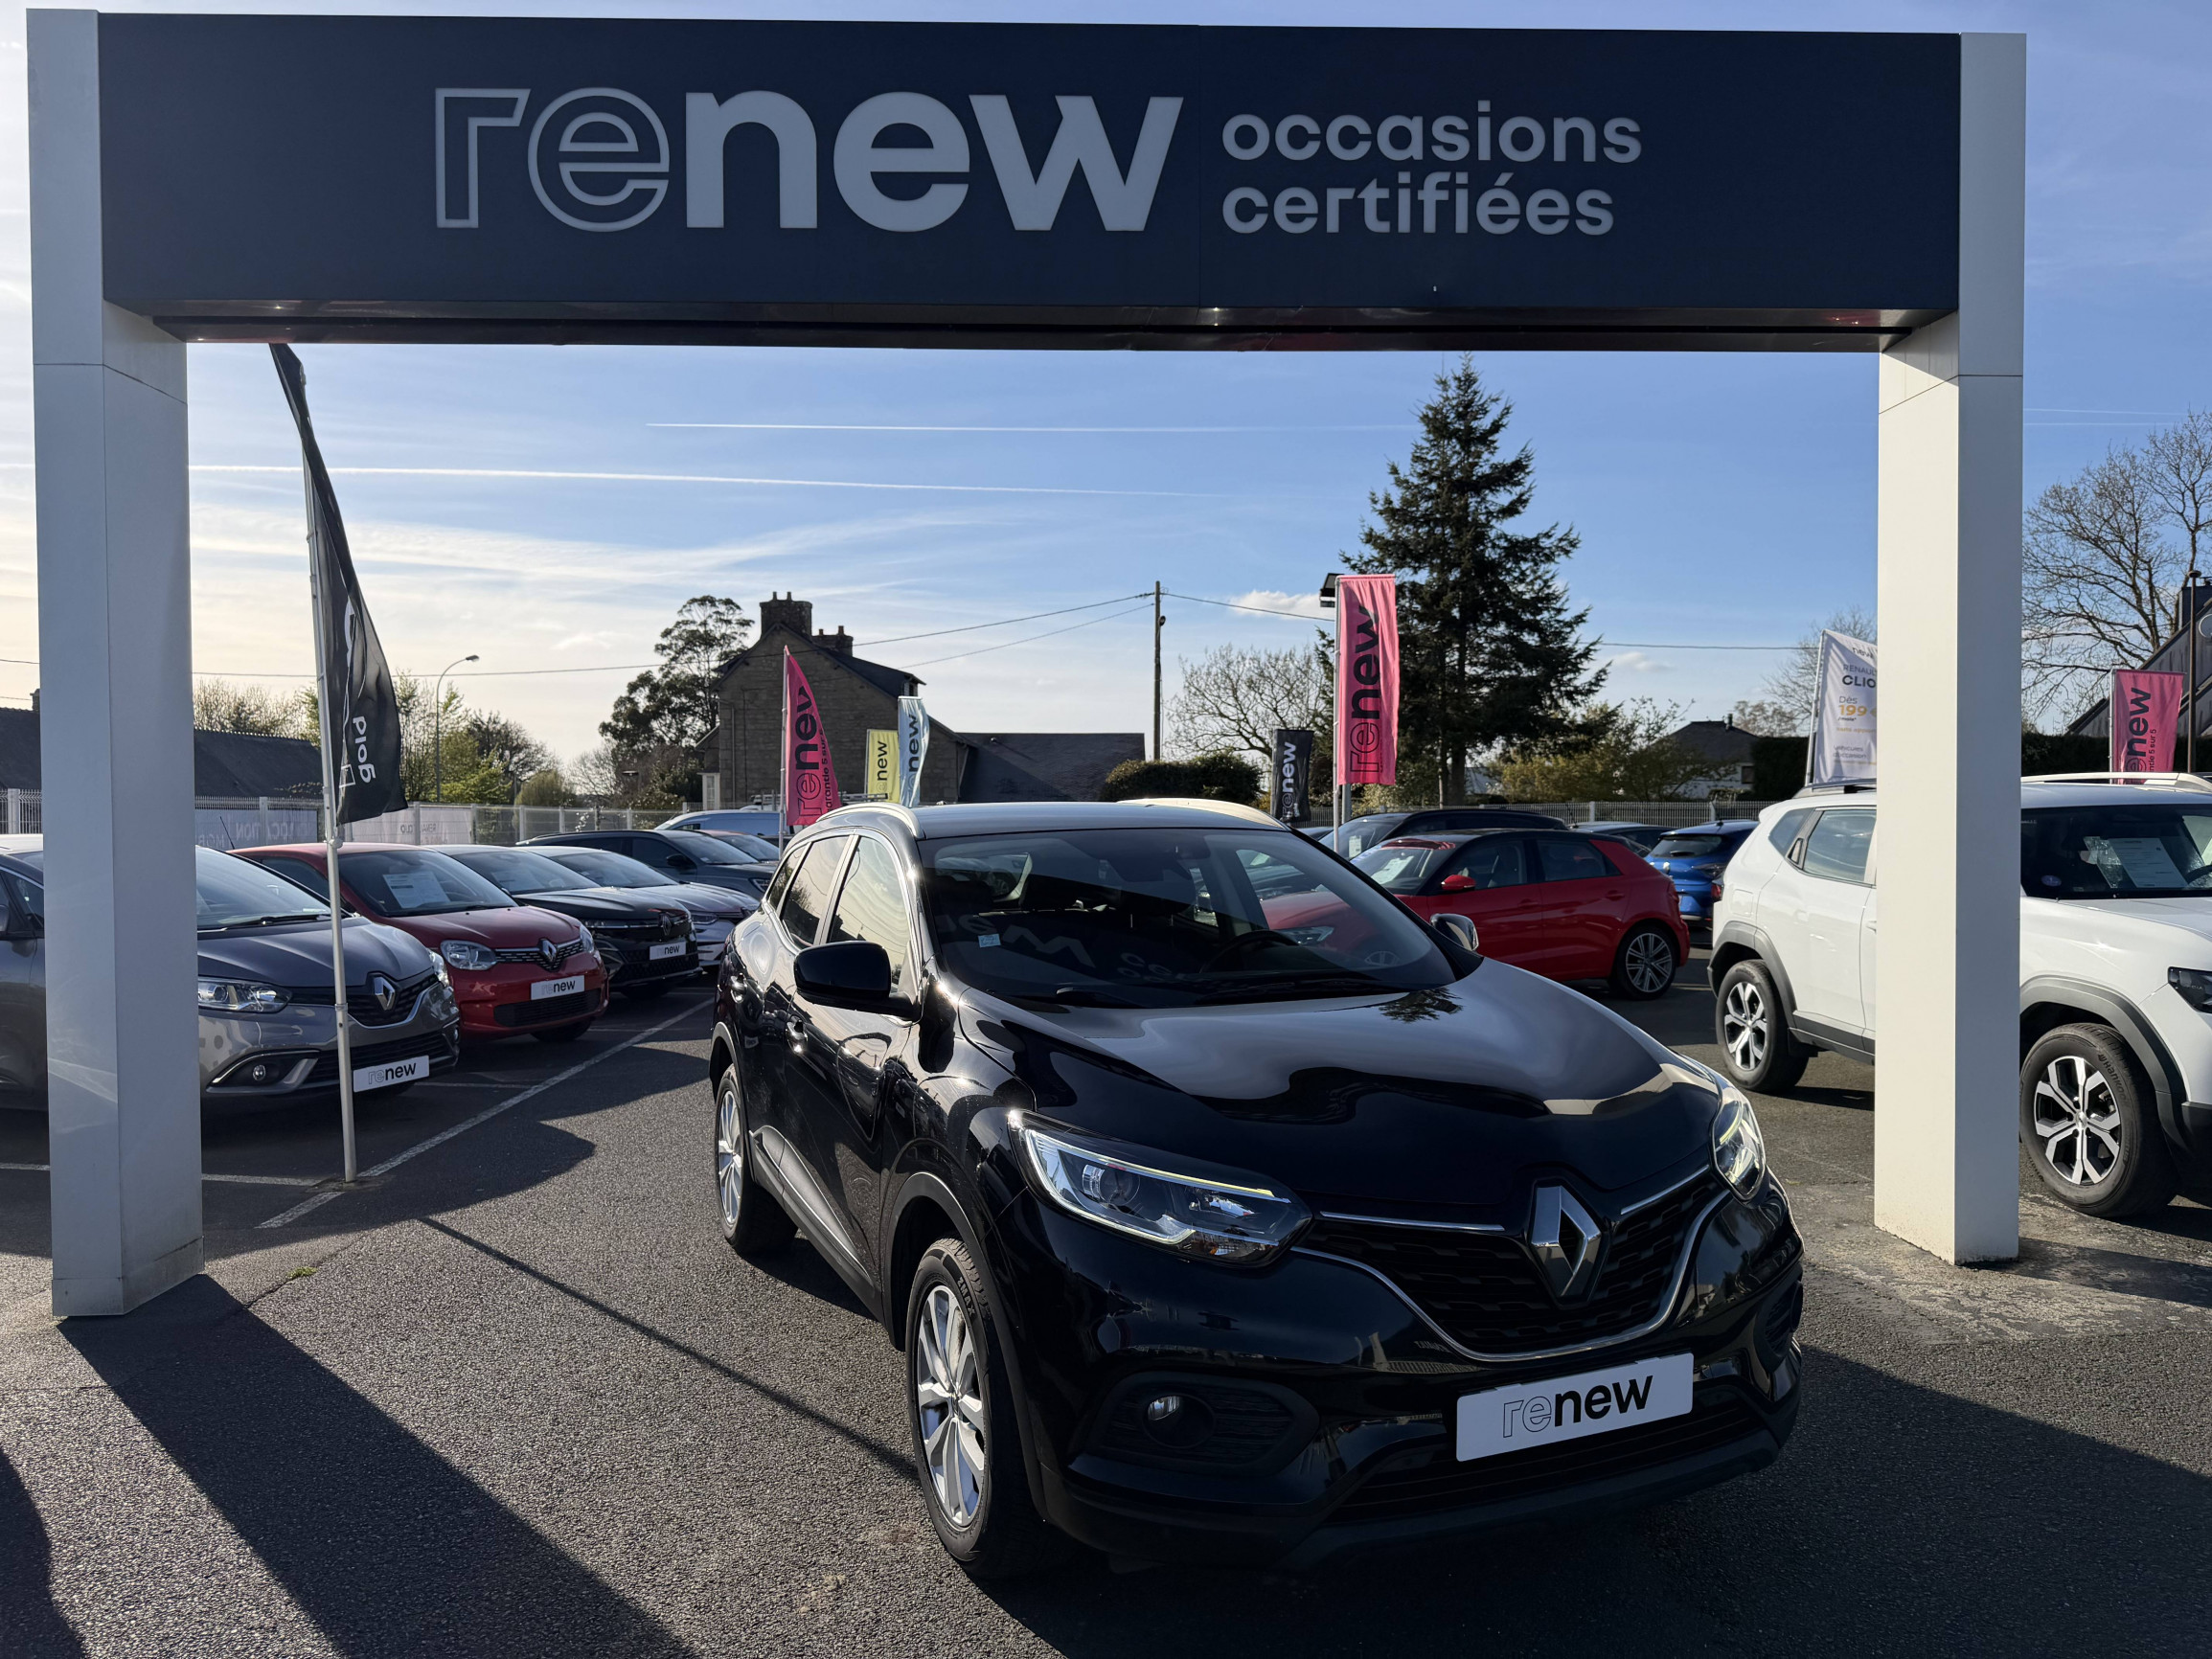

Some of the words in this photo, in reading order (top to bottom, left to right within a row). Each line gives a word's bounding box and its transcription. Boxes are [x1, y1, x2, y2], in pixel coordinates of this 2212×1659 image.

[434, 86, 1184, 232] renew
[1221, 100, 1643, 163] occasions
[1221, 171, 1615, 236] certifiées
[1350, 603, 1381, 774] renew
[1839, 704, 1868, 716] 199
[1842, 674, 1877, 689] CLIO
[2126, 688, 2151, 772] enew
[877, 740, 888, 793] enew
[368, 1062, 417, 1084] renew
[1502, 1375, 1653, 1439] renew
